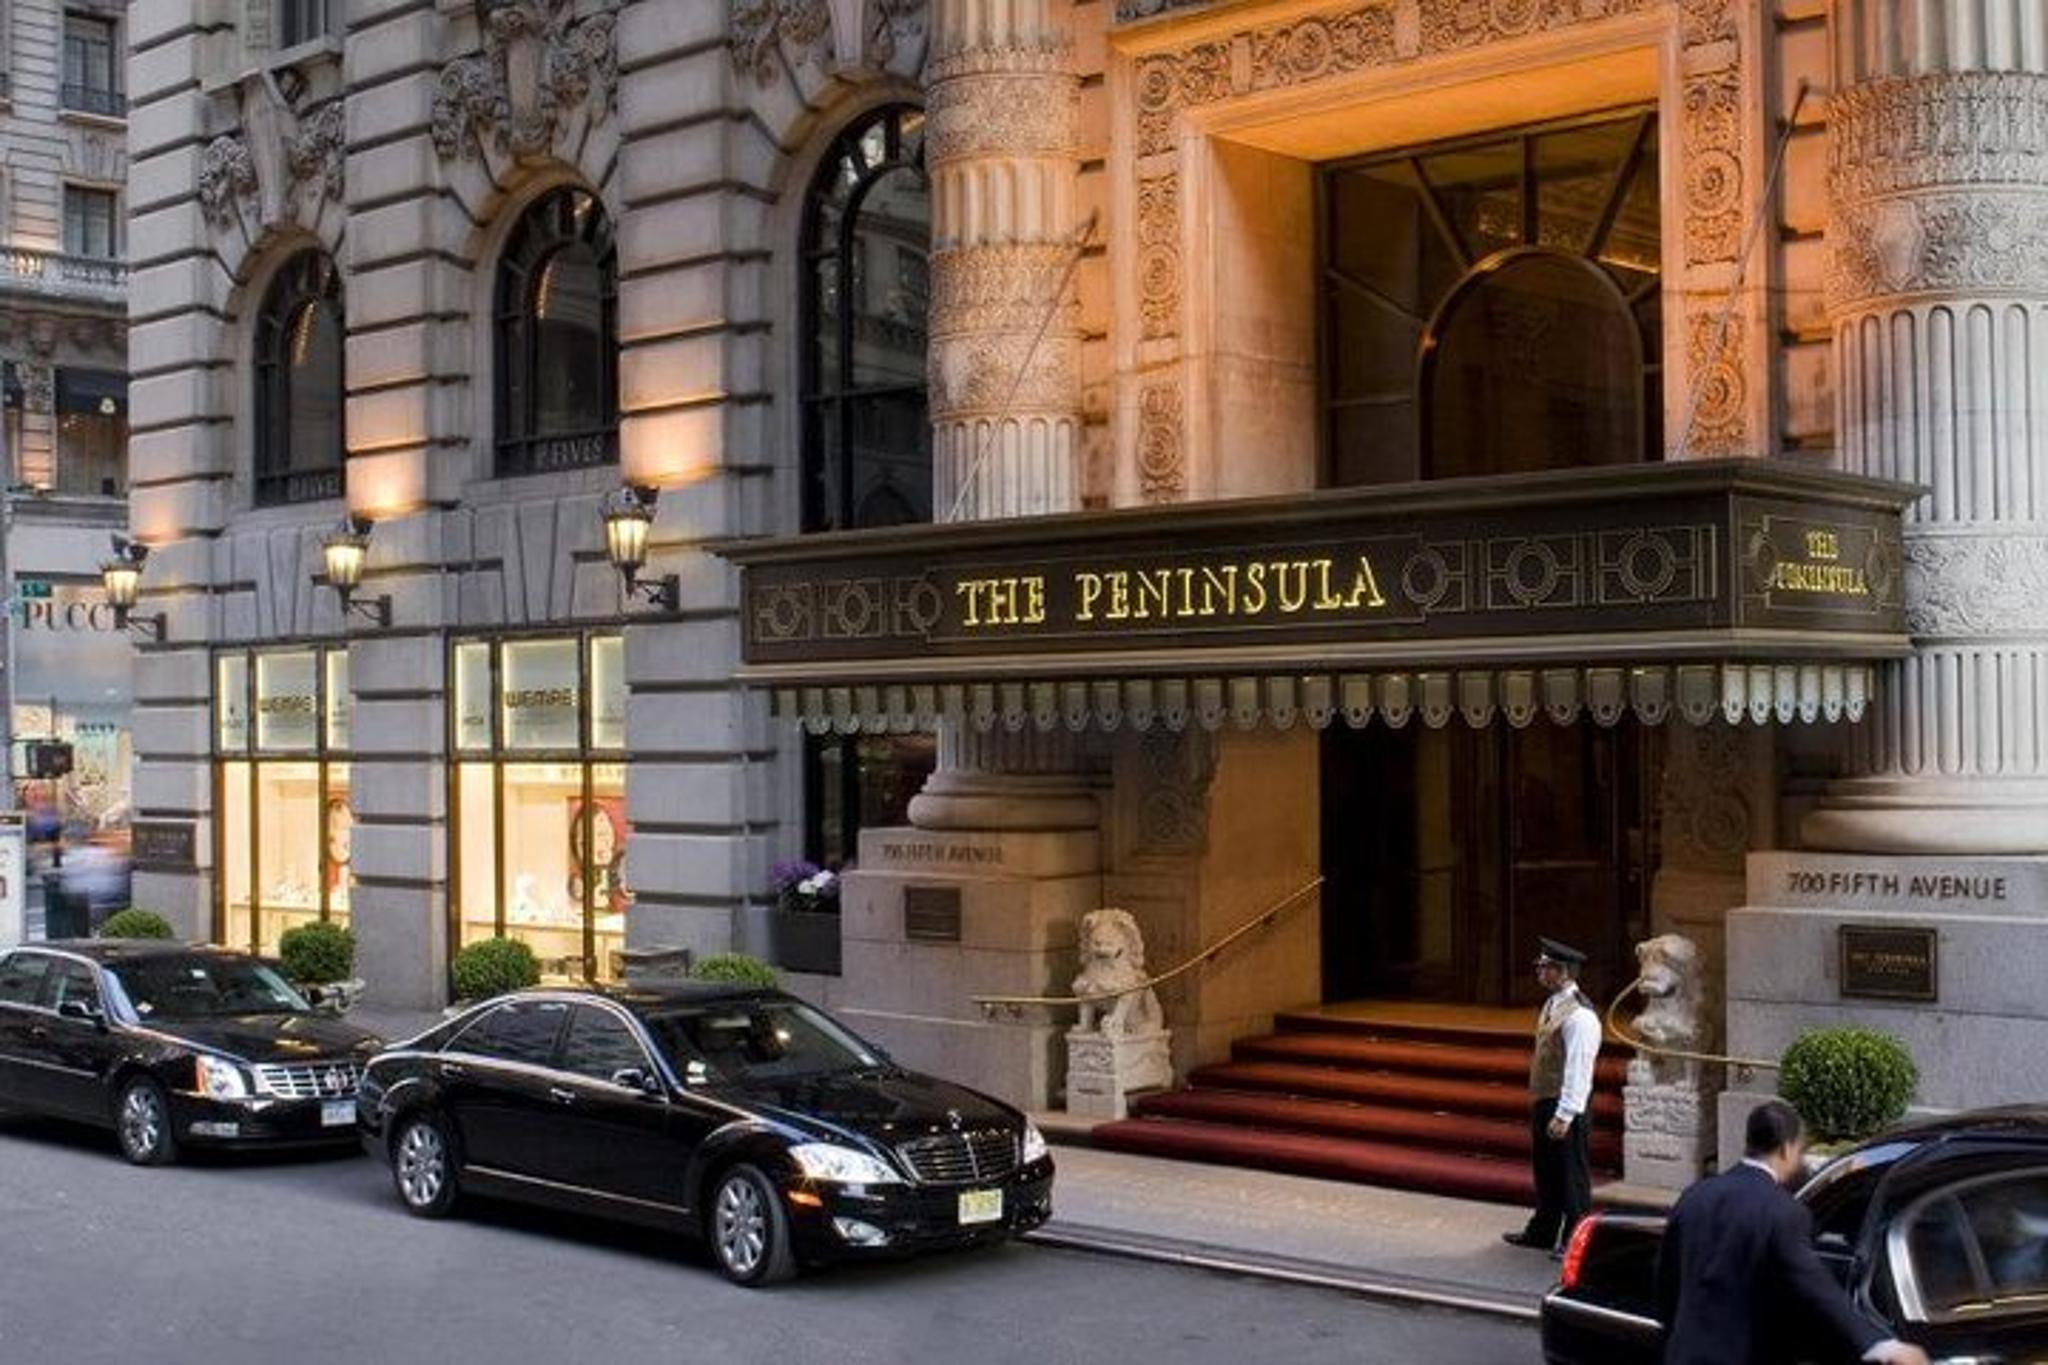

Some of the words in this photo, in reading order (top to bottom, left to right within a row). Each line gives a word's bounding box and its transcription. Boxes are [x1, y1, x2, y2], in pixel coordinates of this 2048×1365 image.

[1806, 530, 1839, 559] THE
[955, 576, 1046, 627] THE
[1075, 555, 1387, 622] PENINSULA
[22, 602, 126, 631] PUCC
[1788, 872, 1826, 893] 700
[1829, 872, 1900, 895] FIFTH
[1909, 874, 2008, 900] AVENUE
